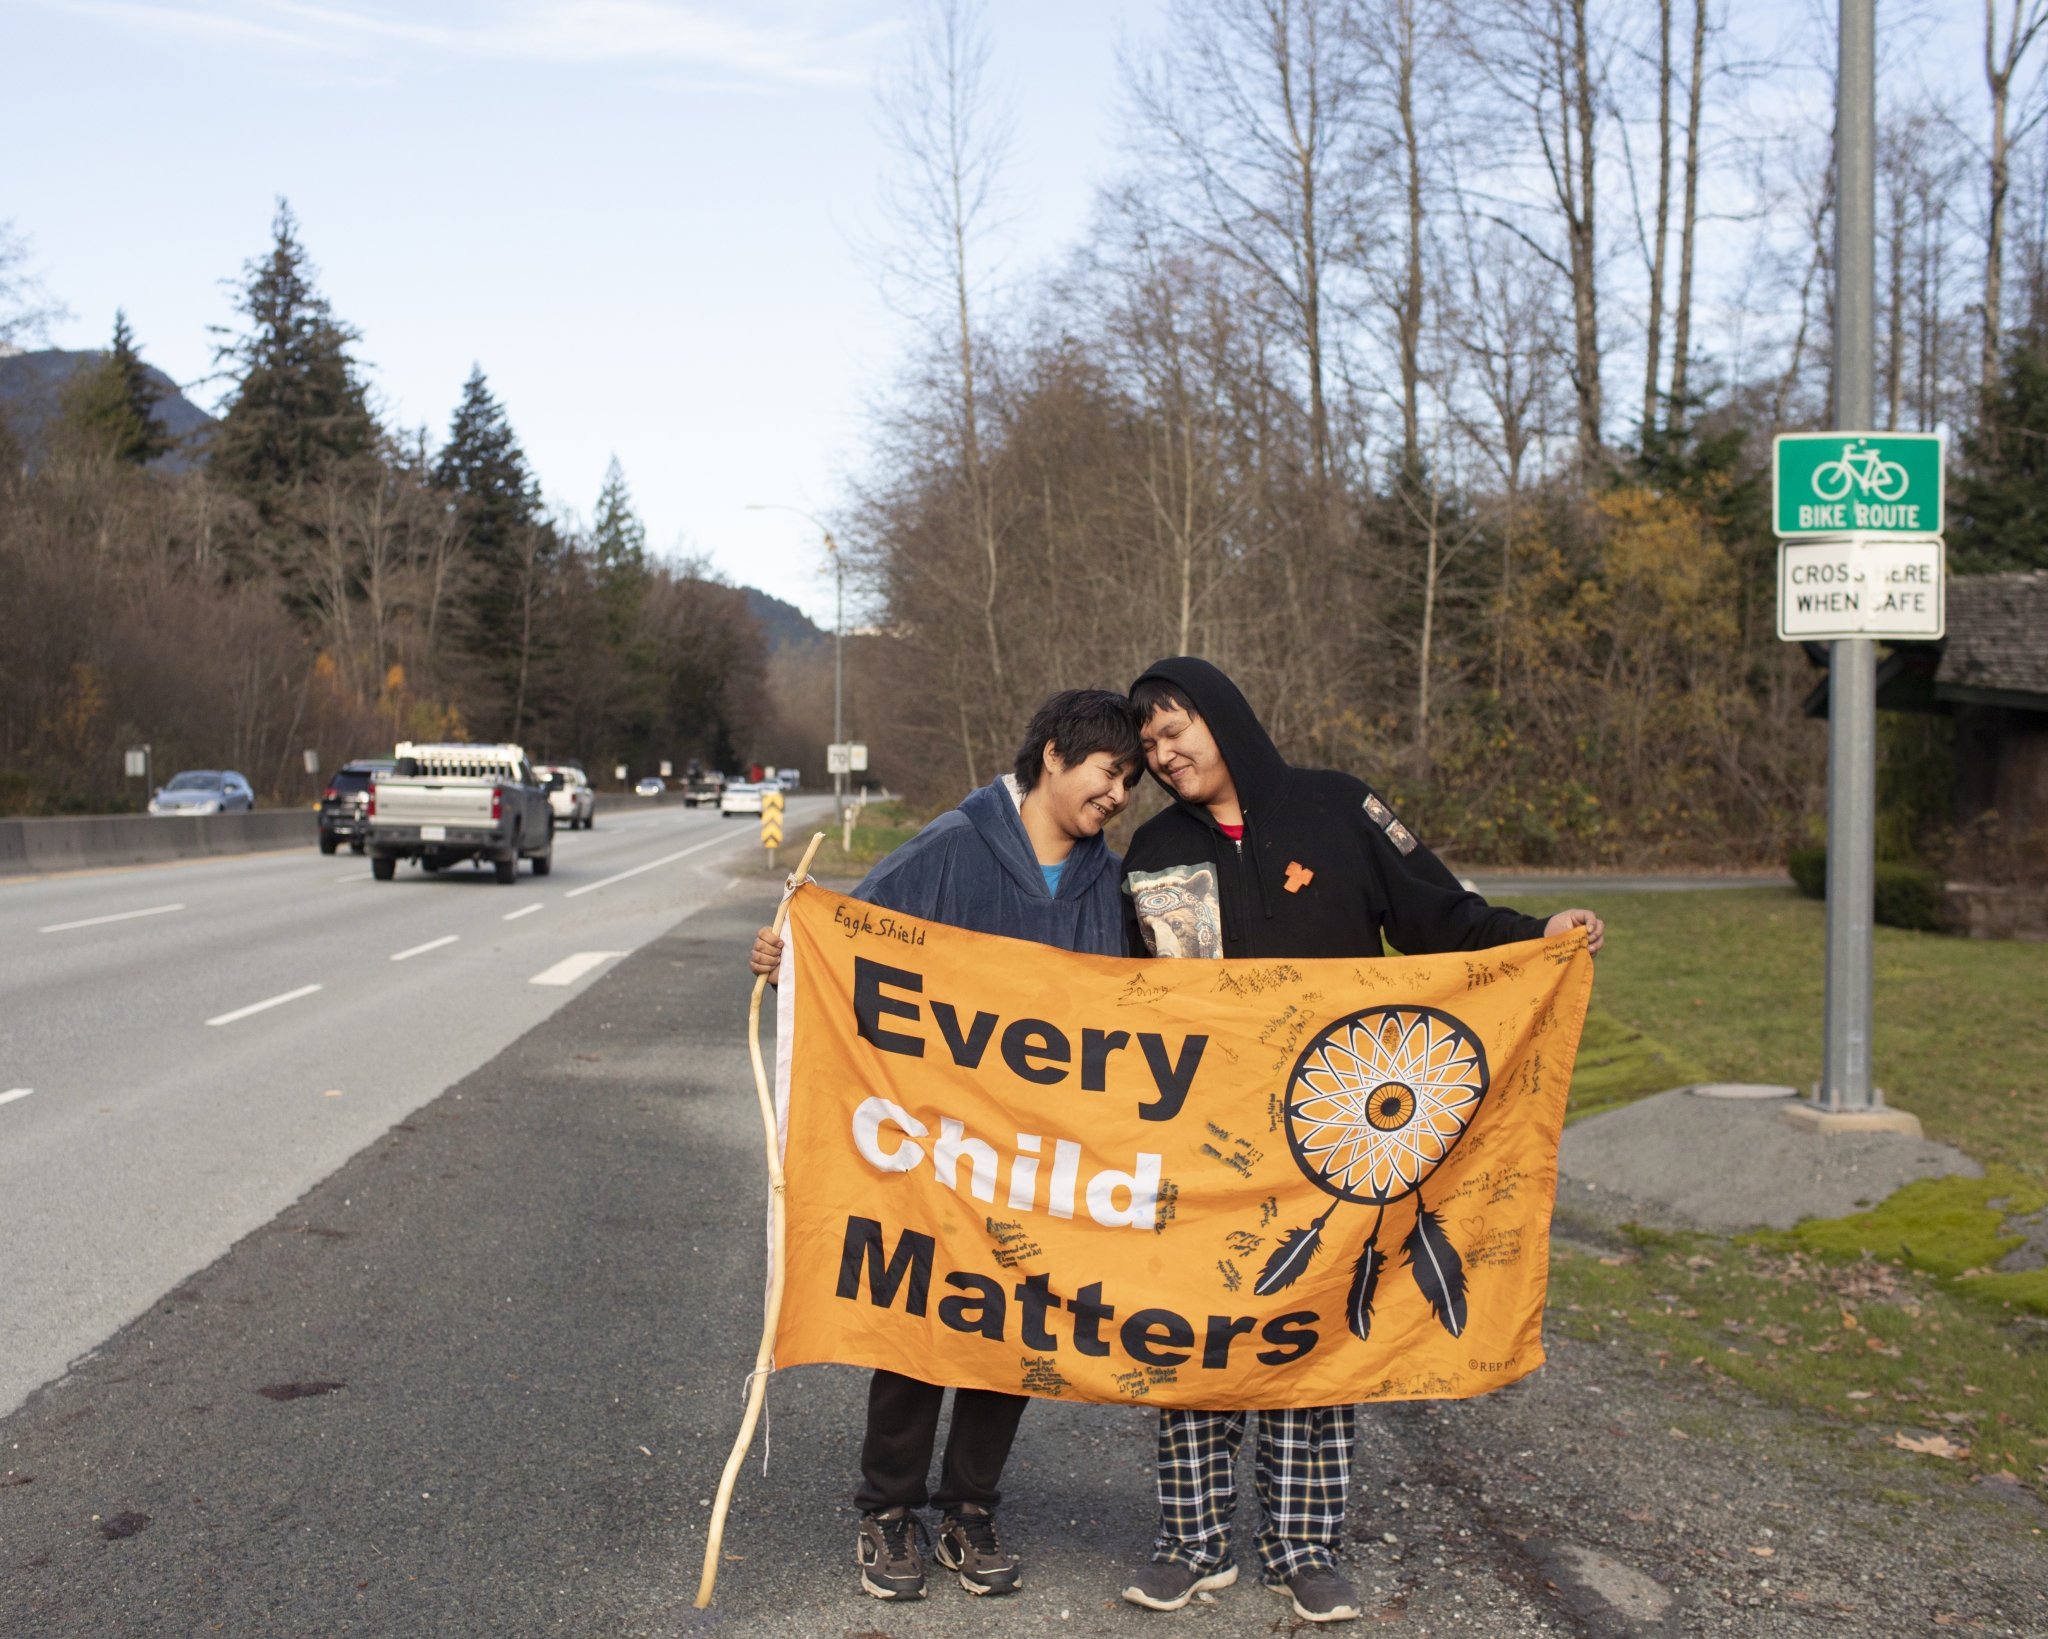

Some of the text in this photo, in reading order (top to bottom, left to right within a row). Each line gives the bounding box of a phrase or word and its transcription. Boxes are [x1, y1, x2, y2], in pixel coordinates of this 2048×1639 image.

[1799, 503, 1920, 528] BIKE ROUTE
[1792, 563, 1866, 584] CROSS
[1796, 593, 1859, 613] WHEN
[834, 906, 926, 946] Eagle Shield
[854, 956, 1209, 1121] Every
[852, 1096, 1162, 1230] Child
[835, 1215, 1320, 1368] Matters
